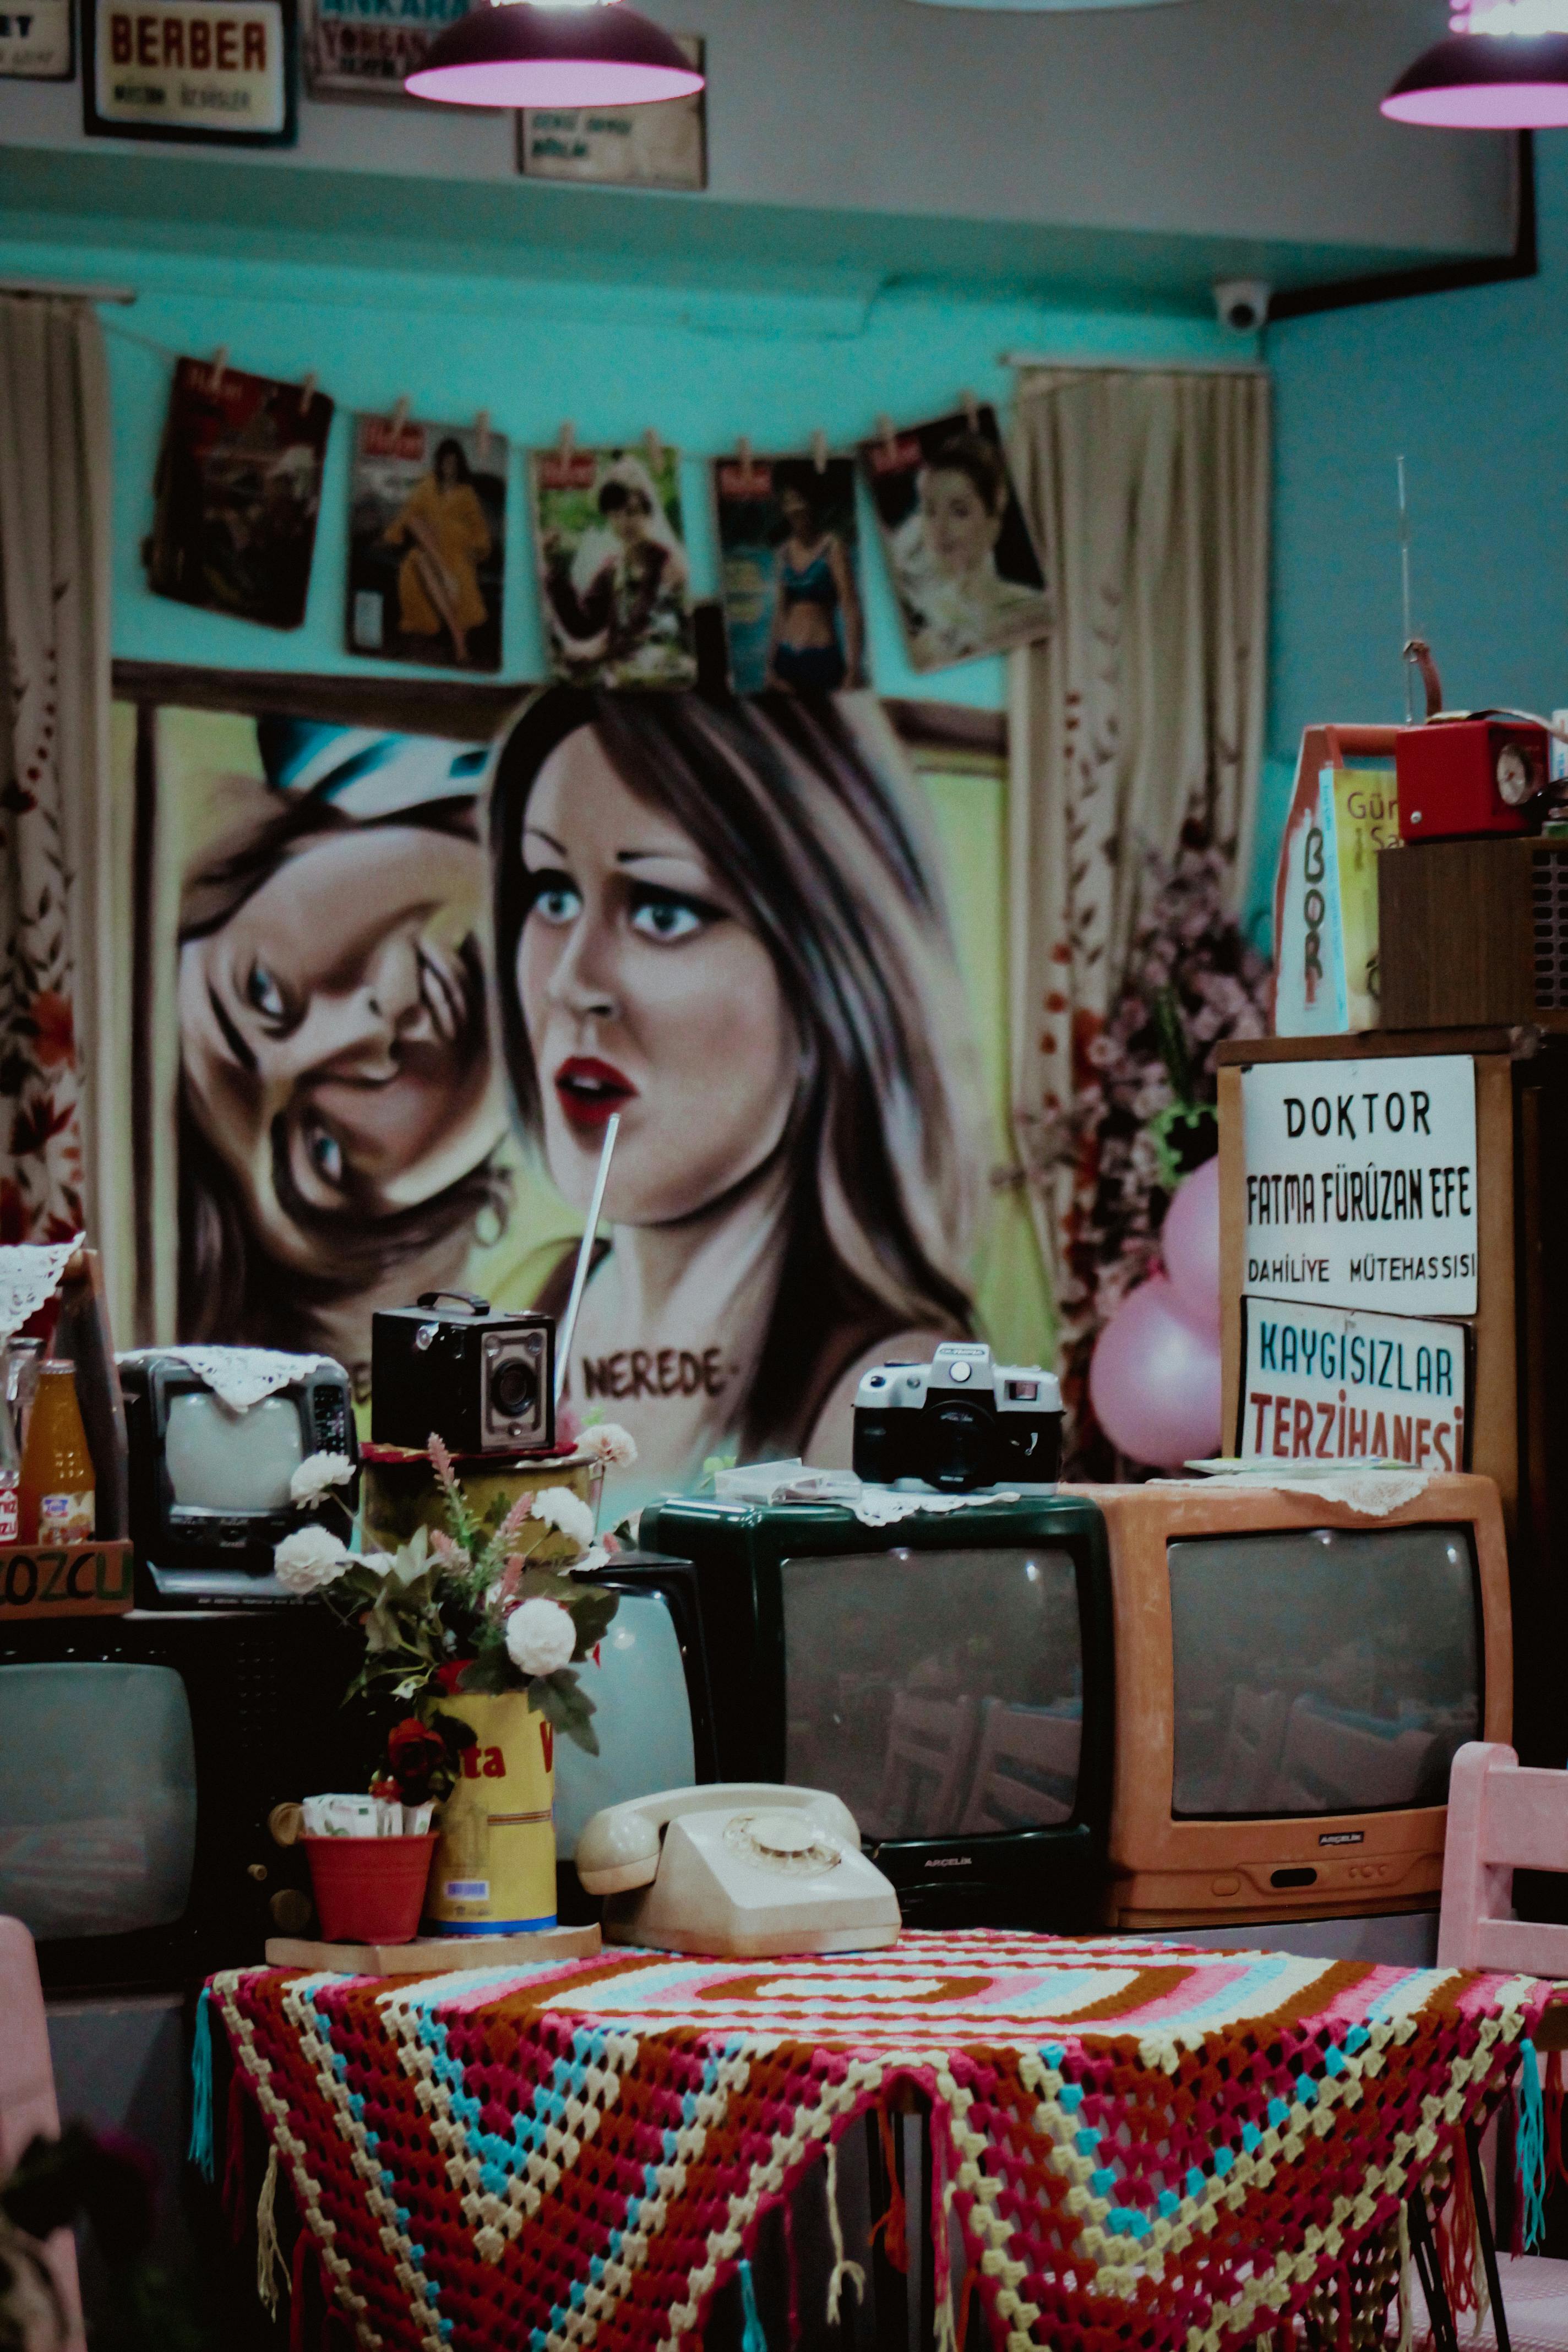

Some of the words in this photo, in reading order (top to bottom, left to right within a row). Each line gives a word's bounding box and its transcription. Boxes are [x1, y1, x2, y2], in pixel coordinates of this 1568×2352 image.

[111, 14, 267, 72] BERBER
[1283, 1090, 1431, 1140] DOKTOR
[1247, 1173, 1315, 1226] FATMA
[1430, 1166, 1471, 1218] EFE
[1248, 1253, 1330, 1283] DAHİLİYE
[1349, 1253, 1477, 1283] MÜTEHASSISI
[582, 1347, 727, 1399] NEREDE
[1259, 1321, 1452, 1397] KAYGISIZLAR
[1250, 1388, 1464, 1472] TERZİHANESİ
[0, 1552, 134, 1605] OZCU
